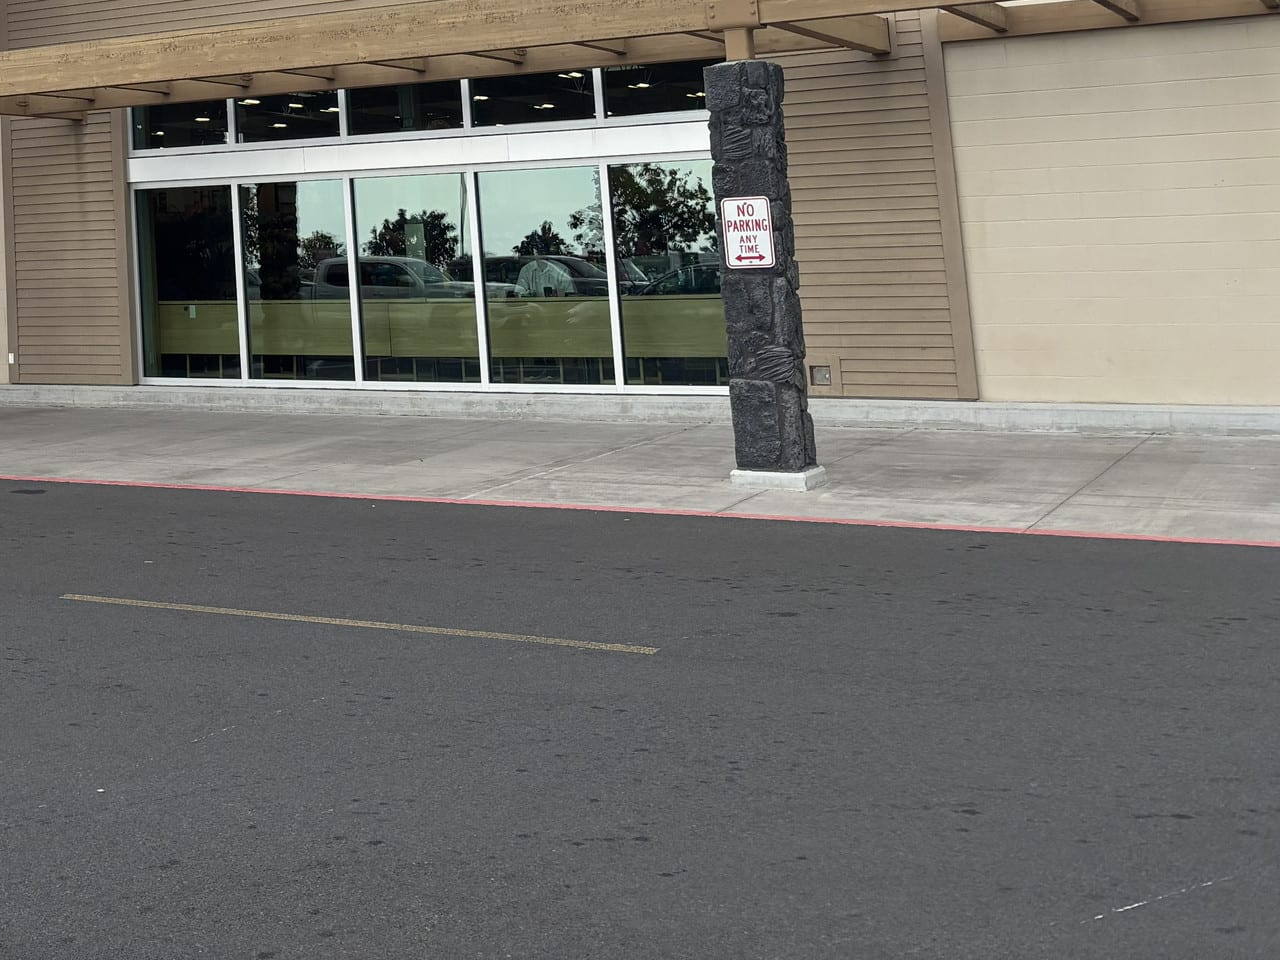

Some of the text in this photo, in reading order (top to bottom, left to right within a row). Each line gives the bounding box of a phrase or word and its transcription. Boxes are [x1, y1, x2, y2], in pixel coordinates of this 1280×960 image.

[736, 204, 755, 217] NO
[727, 219, 768, 232] PARKING
[740, 235, 758, 244] ANY
[739, 244, 760, 254] TIME
